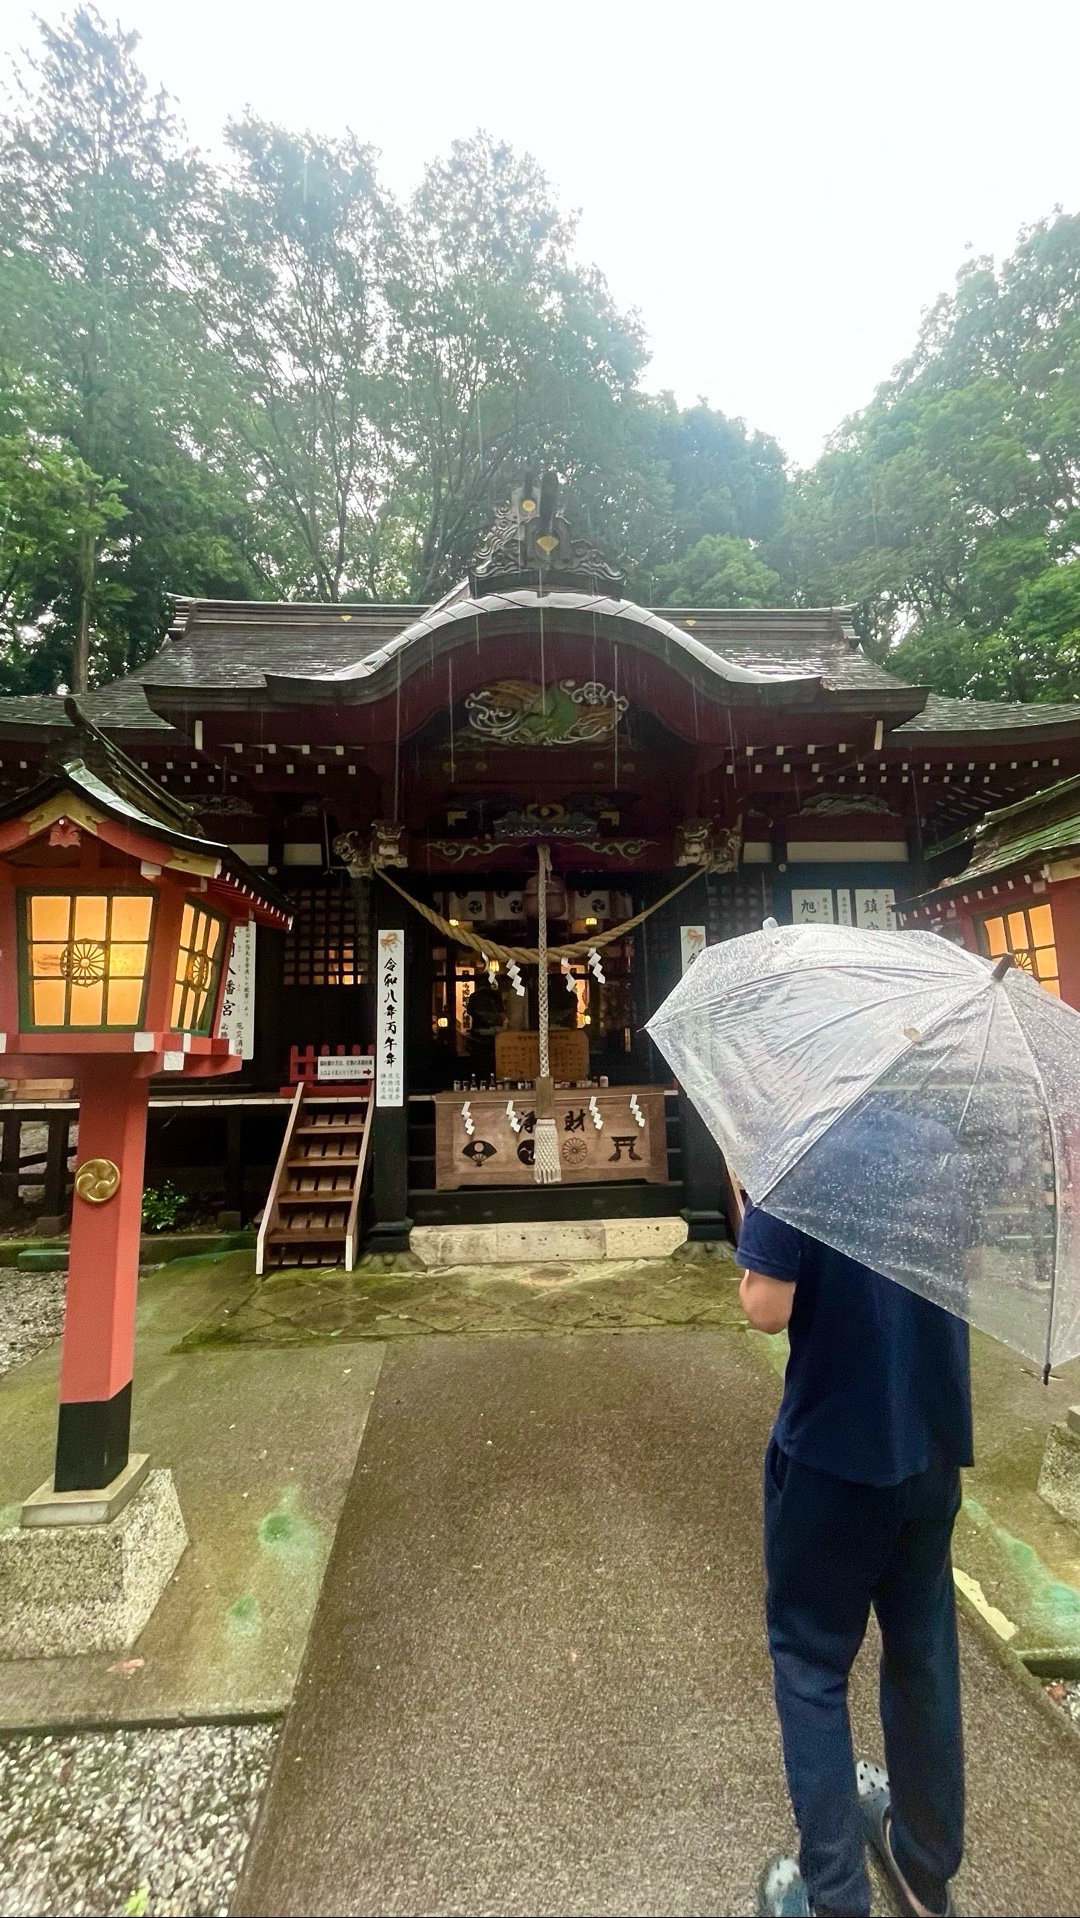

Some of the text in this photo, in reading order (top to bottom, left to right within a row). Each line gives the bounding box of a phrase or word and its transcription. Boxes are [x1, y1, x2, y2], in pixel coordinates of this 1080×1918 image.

[383, 957, 398, 1068] 令和八年丙午年
